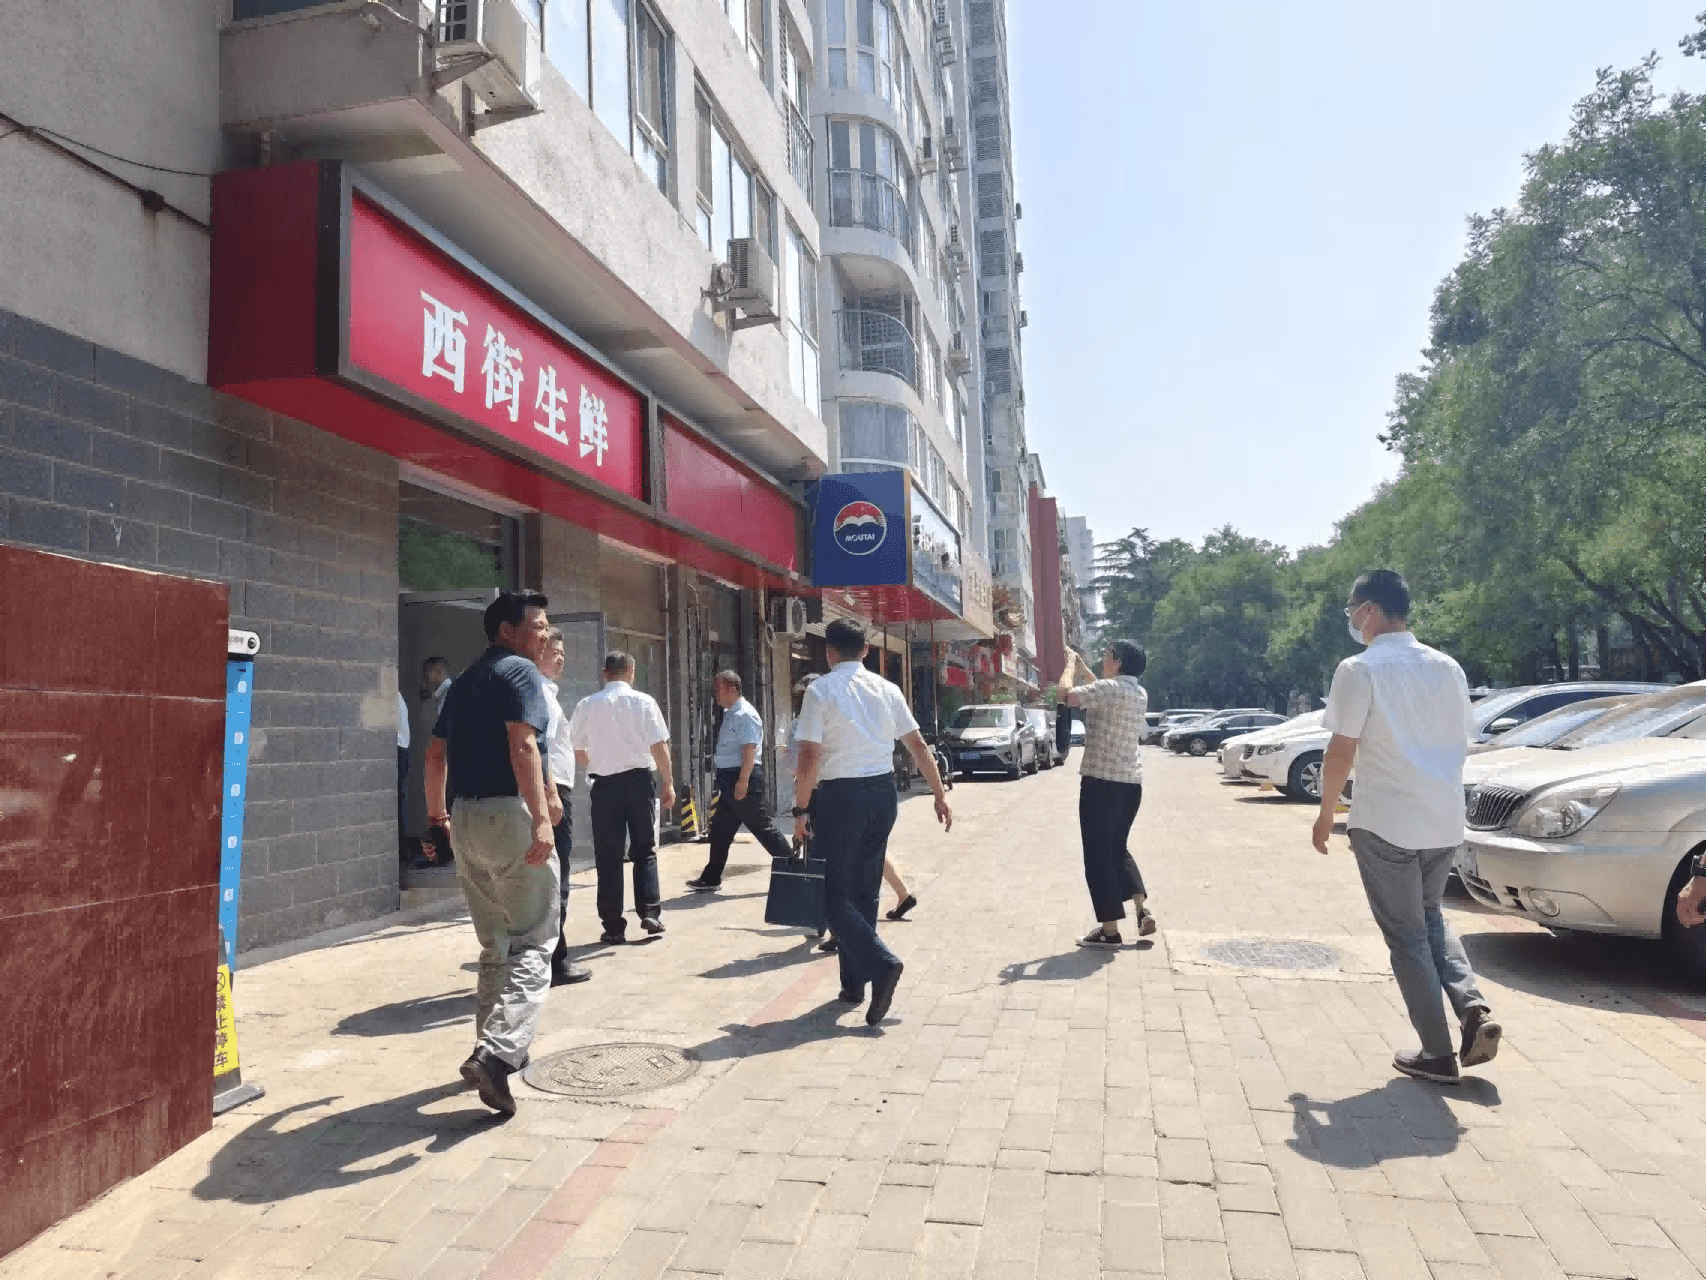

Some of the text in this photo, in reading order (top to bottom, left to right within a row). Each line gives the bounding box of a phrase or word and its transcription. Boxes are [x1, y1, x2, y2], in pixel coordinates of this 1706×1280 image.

[420, 290, 609, 467] 西街生鲜
[845, 533, 876, 542] MOUTAI
